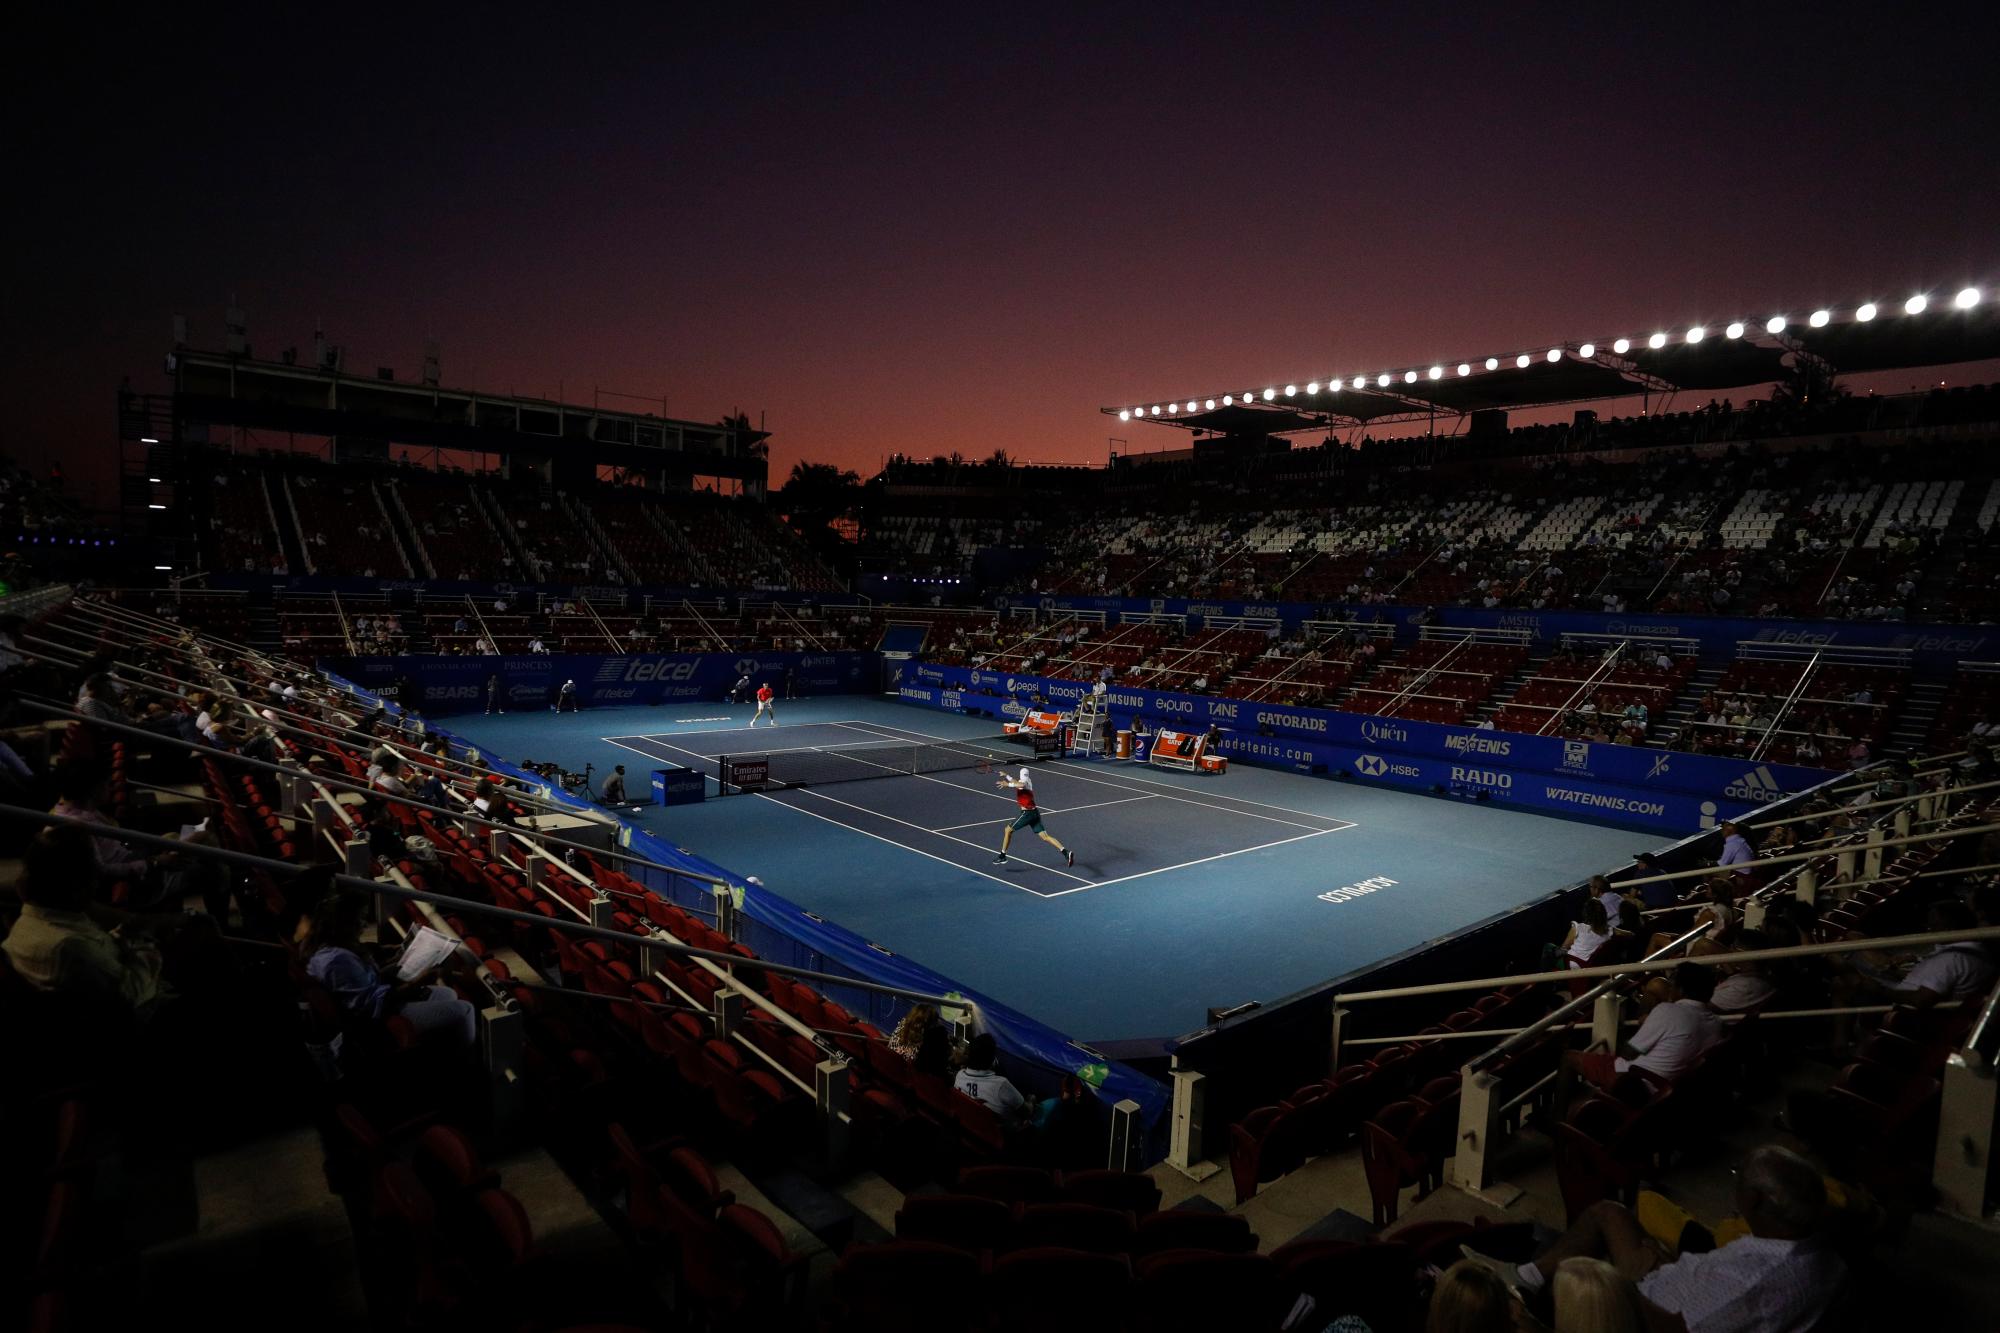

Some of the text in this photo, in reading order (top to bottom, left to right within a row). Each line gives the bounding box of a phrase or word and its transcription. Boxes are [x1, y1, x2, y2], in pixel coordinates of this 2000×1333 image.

[1243, 606, 1278, 618] SEARS
[1498, 615, 1541, 628] AMSTEL
[1772, 629, 1839, 647] telcel
[1912, 633, 1989, 655] telcel
[624, 656, 703, 682] telcel
[425, 686, 480, 700] SEARS
[900, 687, 931, 701] SAMSUNG
[1016, 681, 1039, 693] pepsi
[942, 690, 961, 700] AMSTEL
[1108, 693, 1144, 707] MSUNG
[942, 697, 962, 709] ULTRA
[1208, 701, 1238, 718] TANE
[1256, 711, 1328, 732] GATORADE
[1360, 719, 1408, 744] Quién
[733, 765, 768, 776] Emirates
[1390, 764, 1420, 777] HSBC
[1450, 766, 1512, 789] RADO
[1545, 787, 1665, 817] WTATENNIS.COM
[1724, 786, 1788, 804] adidas
[1317, 876, 1400, 903] ACAPULCO
